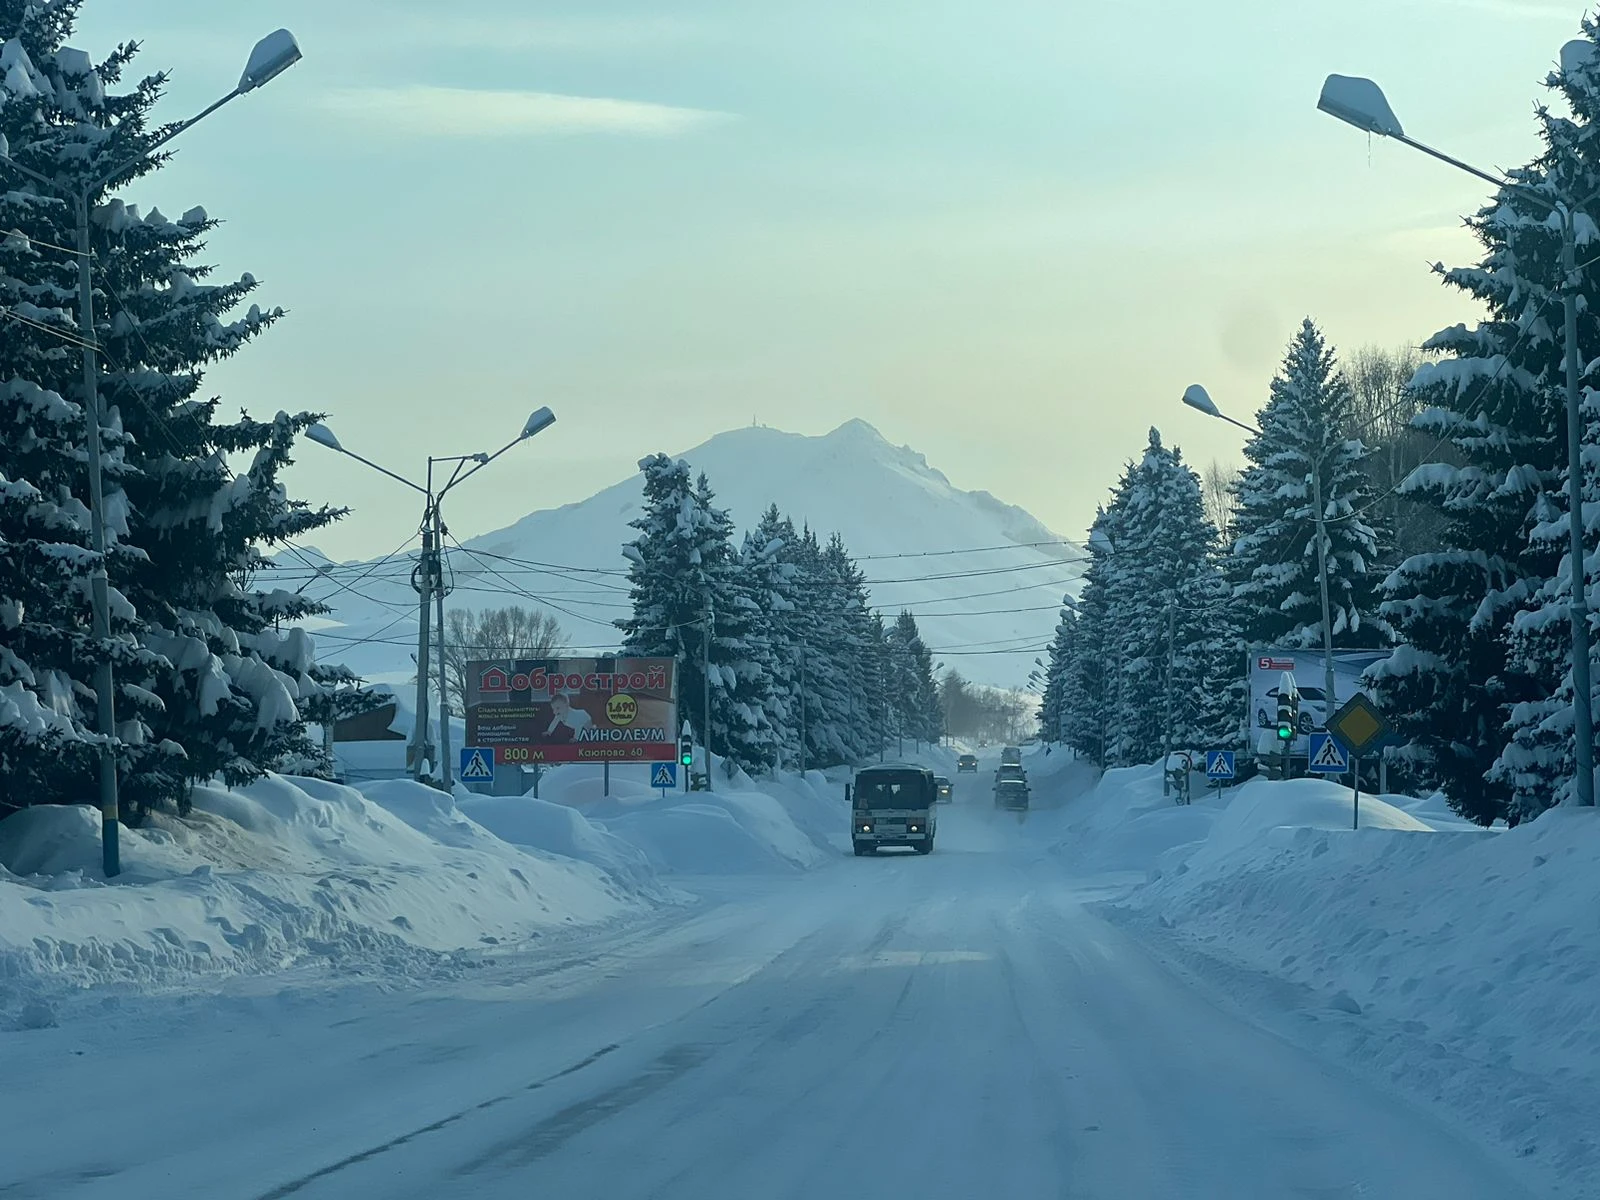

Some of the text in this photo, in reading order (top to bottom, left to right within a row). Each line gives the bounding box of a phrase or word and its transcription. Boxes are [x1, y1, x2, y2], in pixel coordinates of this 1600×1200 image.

[1260, 658, 1270, 669] 5
[477, 664, 666, 696] Добрострой
[607, 702, 635, 712] 1.690
[578, 728, 665, 742] ЛИНОЛЕУМ
[504, 748, 544, 760] 800 м
[631, 748, 643, 757] 60
